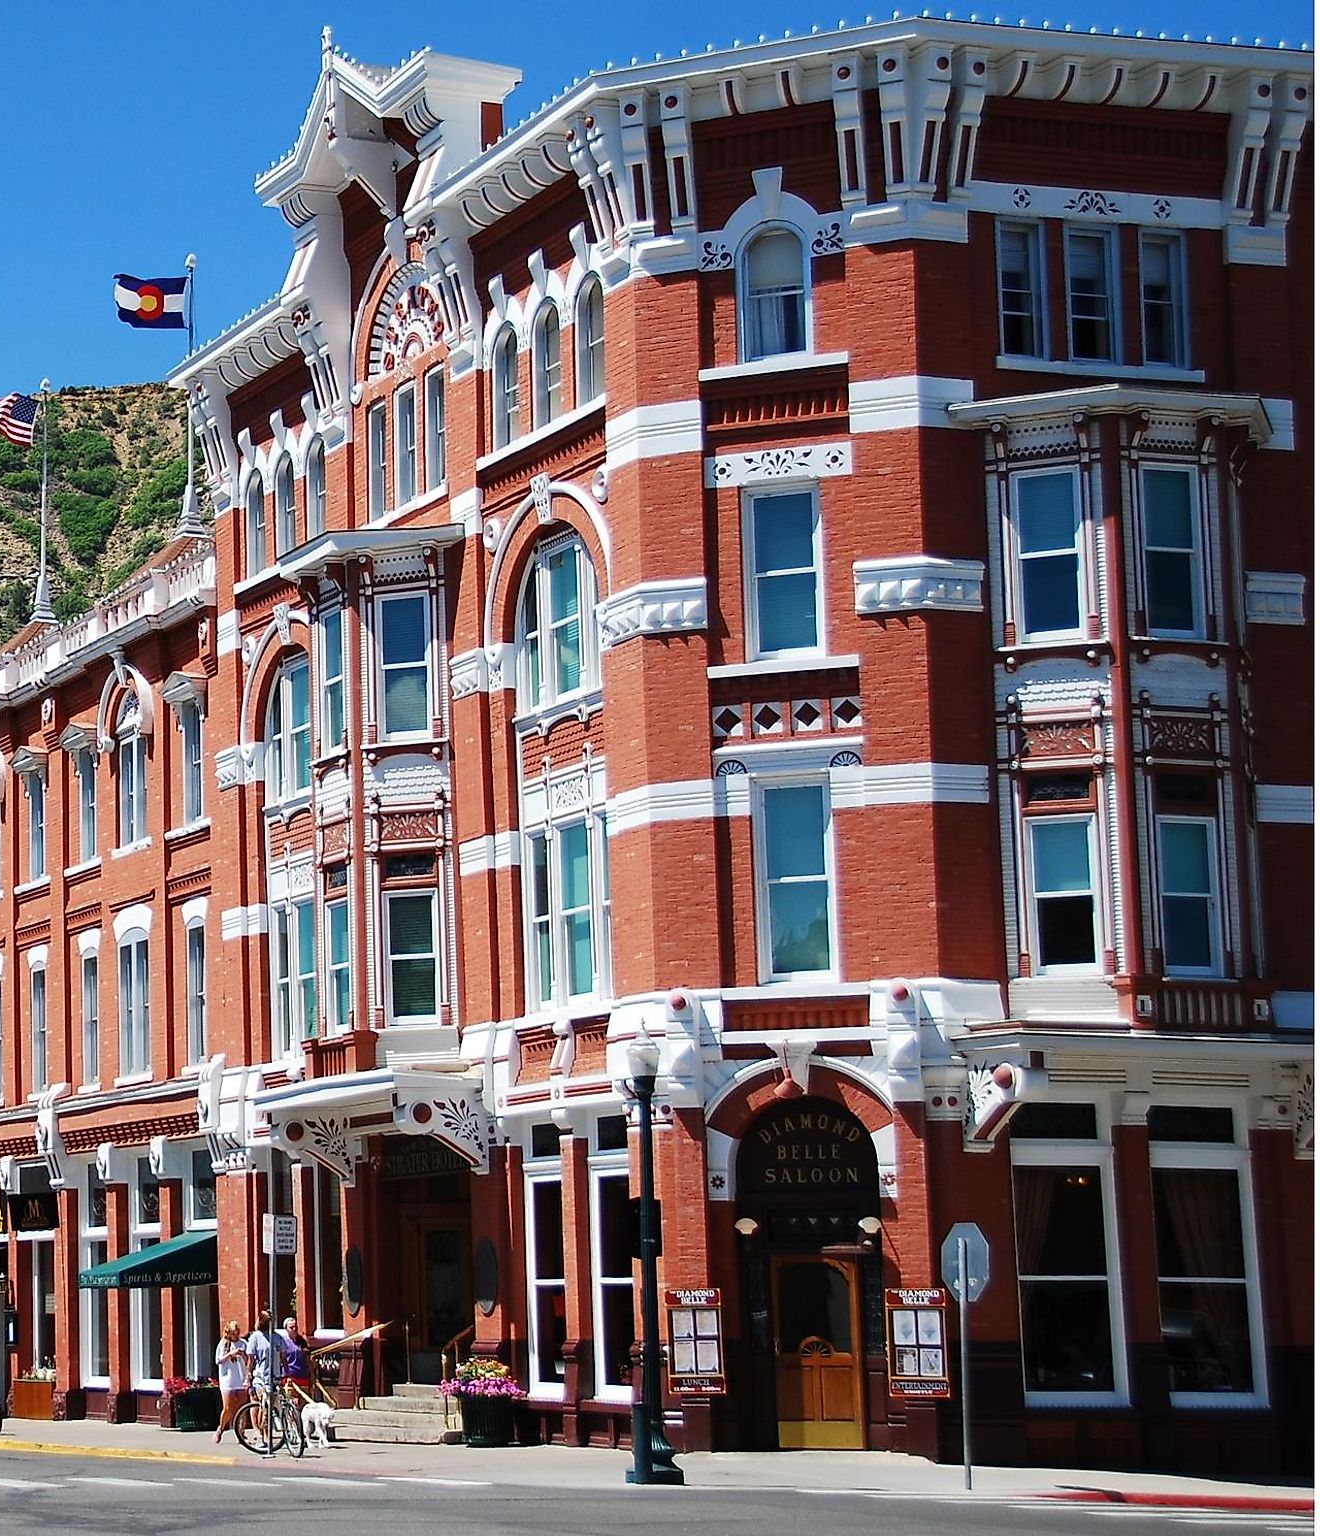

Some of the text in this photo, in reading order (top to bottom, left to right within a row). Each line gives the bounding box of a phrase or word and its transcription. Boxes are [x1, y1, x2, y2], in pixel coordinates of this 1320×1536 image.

[759, 1114, 860, 1144] DIAMOND
[777, 1144, 840, 1160] BELLE
[764, 1167, 859, 1183] SALOON
[123, 1274, 152, 1284] Spirits
[154, 1272, 161, 1281] &
[165, 1270, 212, 1283] Appetizers
[676, 1289, 715, 1298] DIAMOND
[898, 1289, 940, 1298] DIAMOND
[681, 1296, 707, 1304] BELLE
[902, 1296, 930, 1305] BELLE
[682, 1378, 710, 1386] LUNCH
[891, 1381, 947, 1390] ENTERTAINMENT
